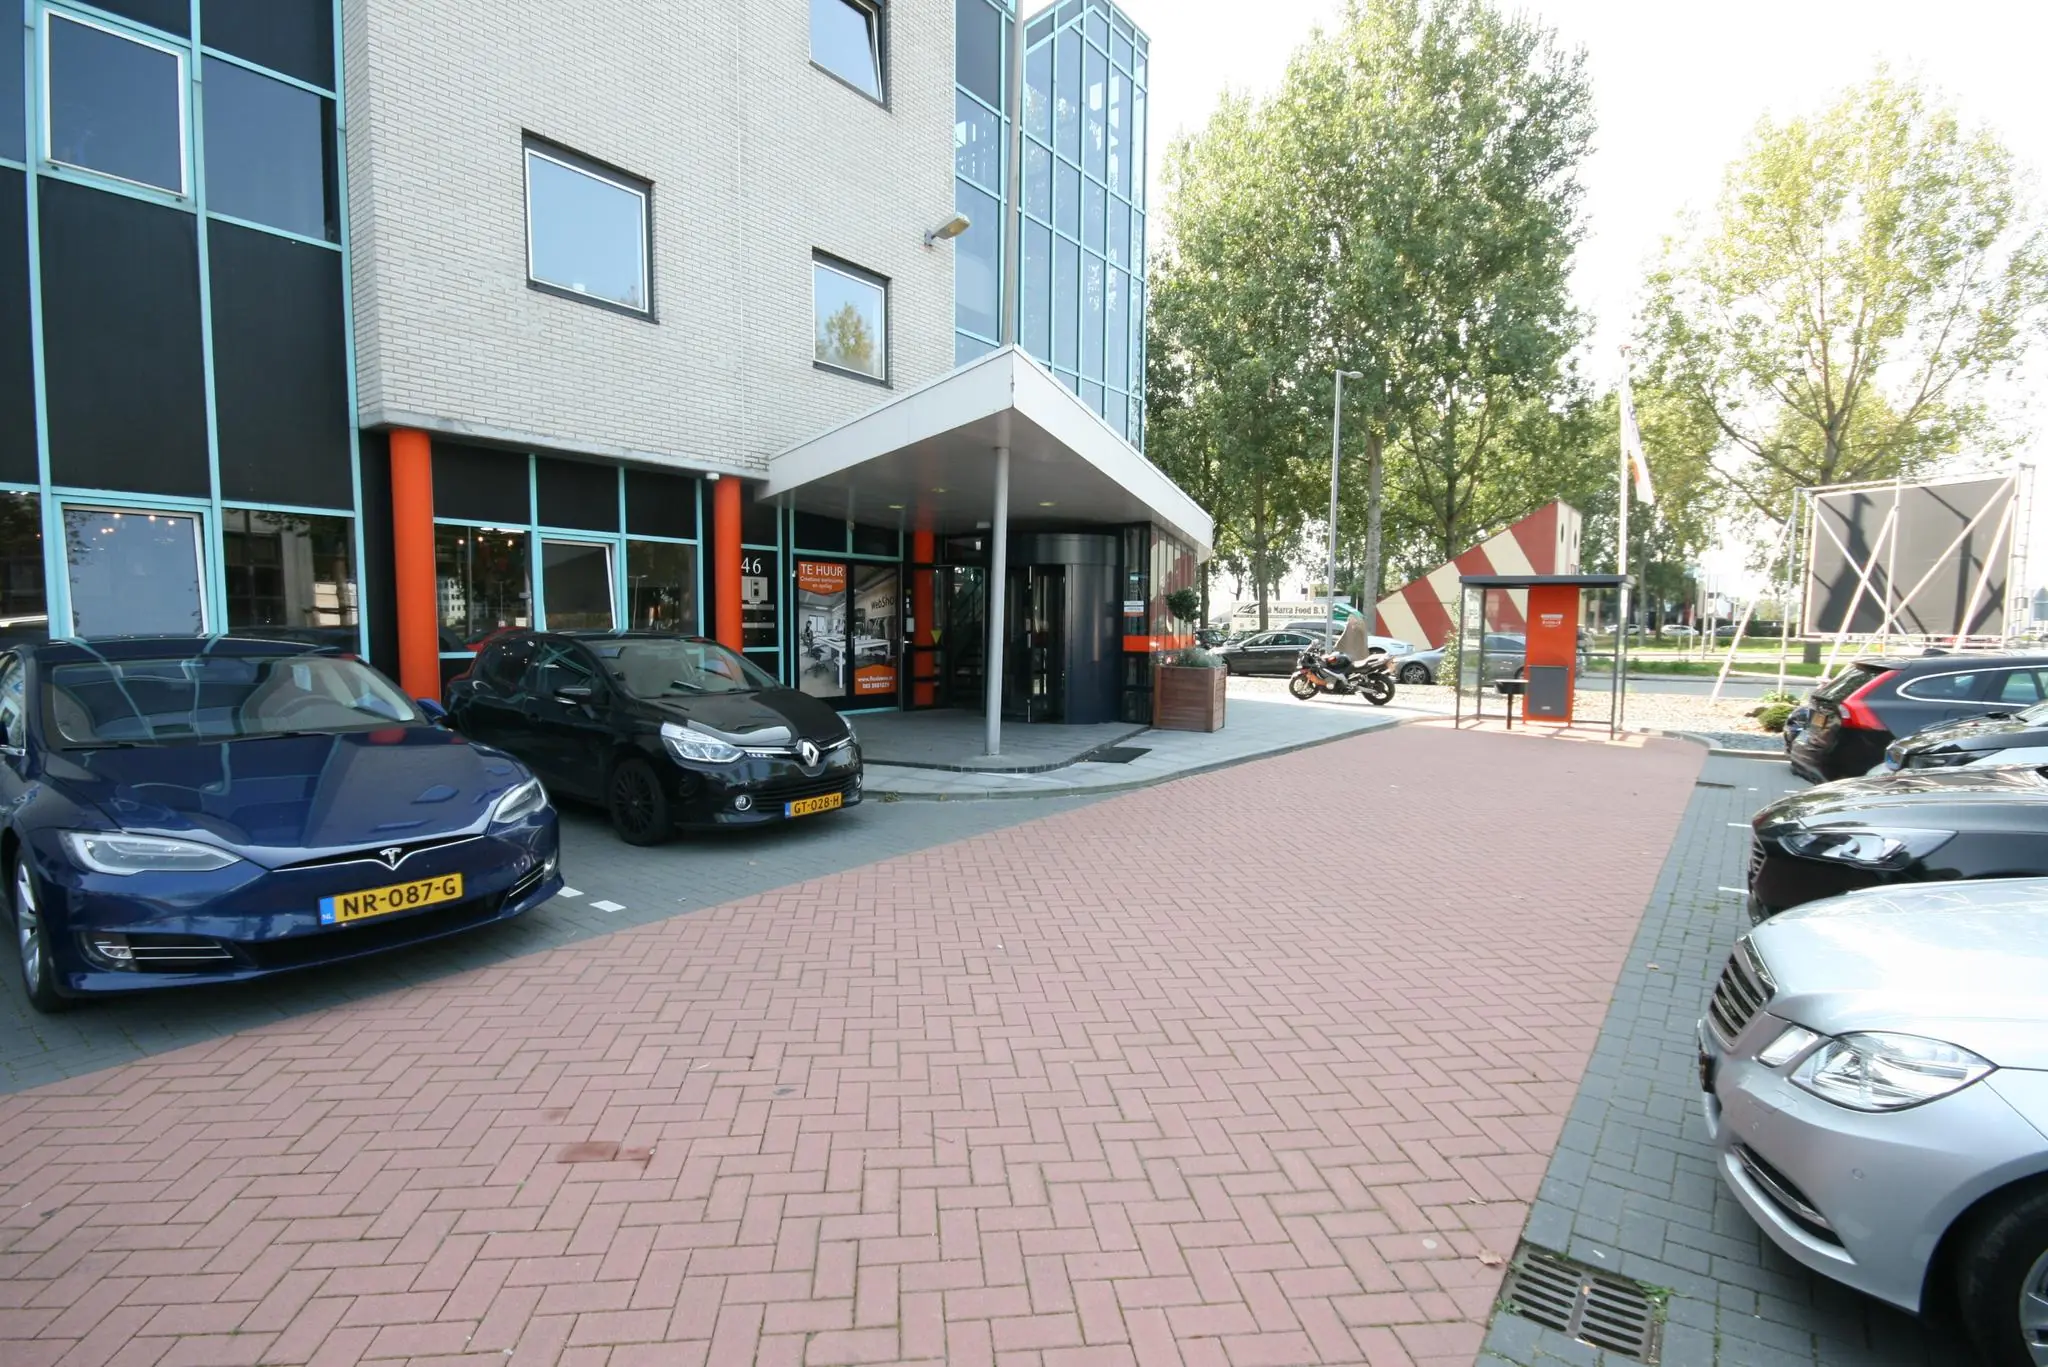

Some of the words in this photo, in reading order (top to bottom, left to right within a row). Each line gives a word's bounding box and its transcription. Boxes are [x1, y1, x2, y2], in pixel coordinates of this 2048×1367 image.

[741, 557, 761, 575] 46
[801, 563, 813, 575] TE
[815, 565, 843, 577] HUUR
[1294, 606, 1312, 614] Food
[794, 795, 839, 814] GT-028-H
[343, 878, 456, 917] NR-087-G
